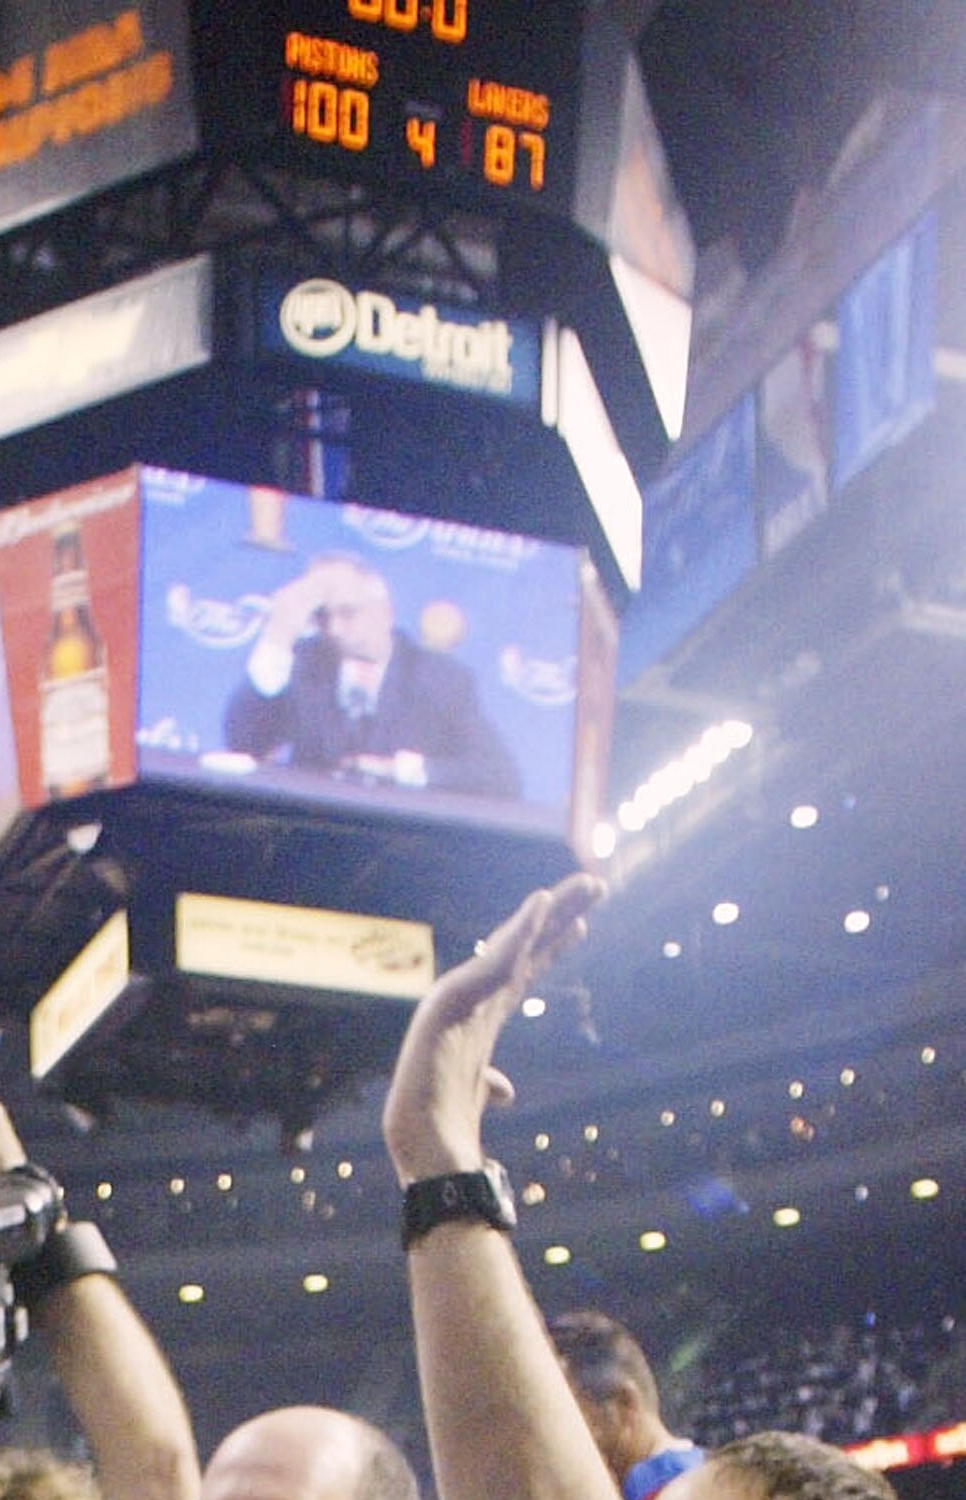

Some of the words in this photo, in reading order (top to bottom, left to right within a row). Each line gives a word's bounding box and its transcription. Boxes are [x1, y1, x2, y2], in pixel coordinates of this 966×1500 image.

[292, 80, 369, 150] 100
[406, 117, 436, 168] 4
[485, 125, 545, 190] 87
[356, 290, 512, 376] Detroit
